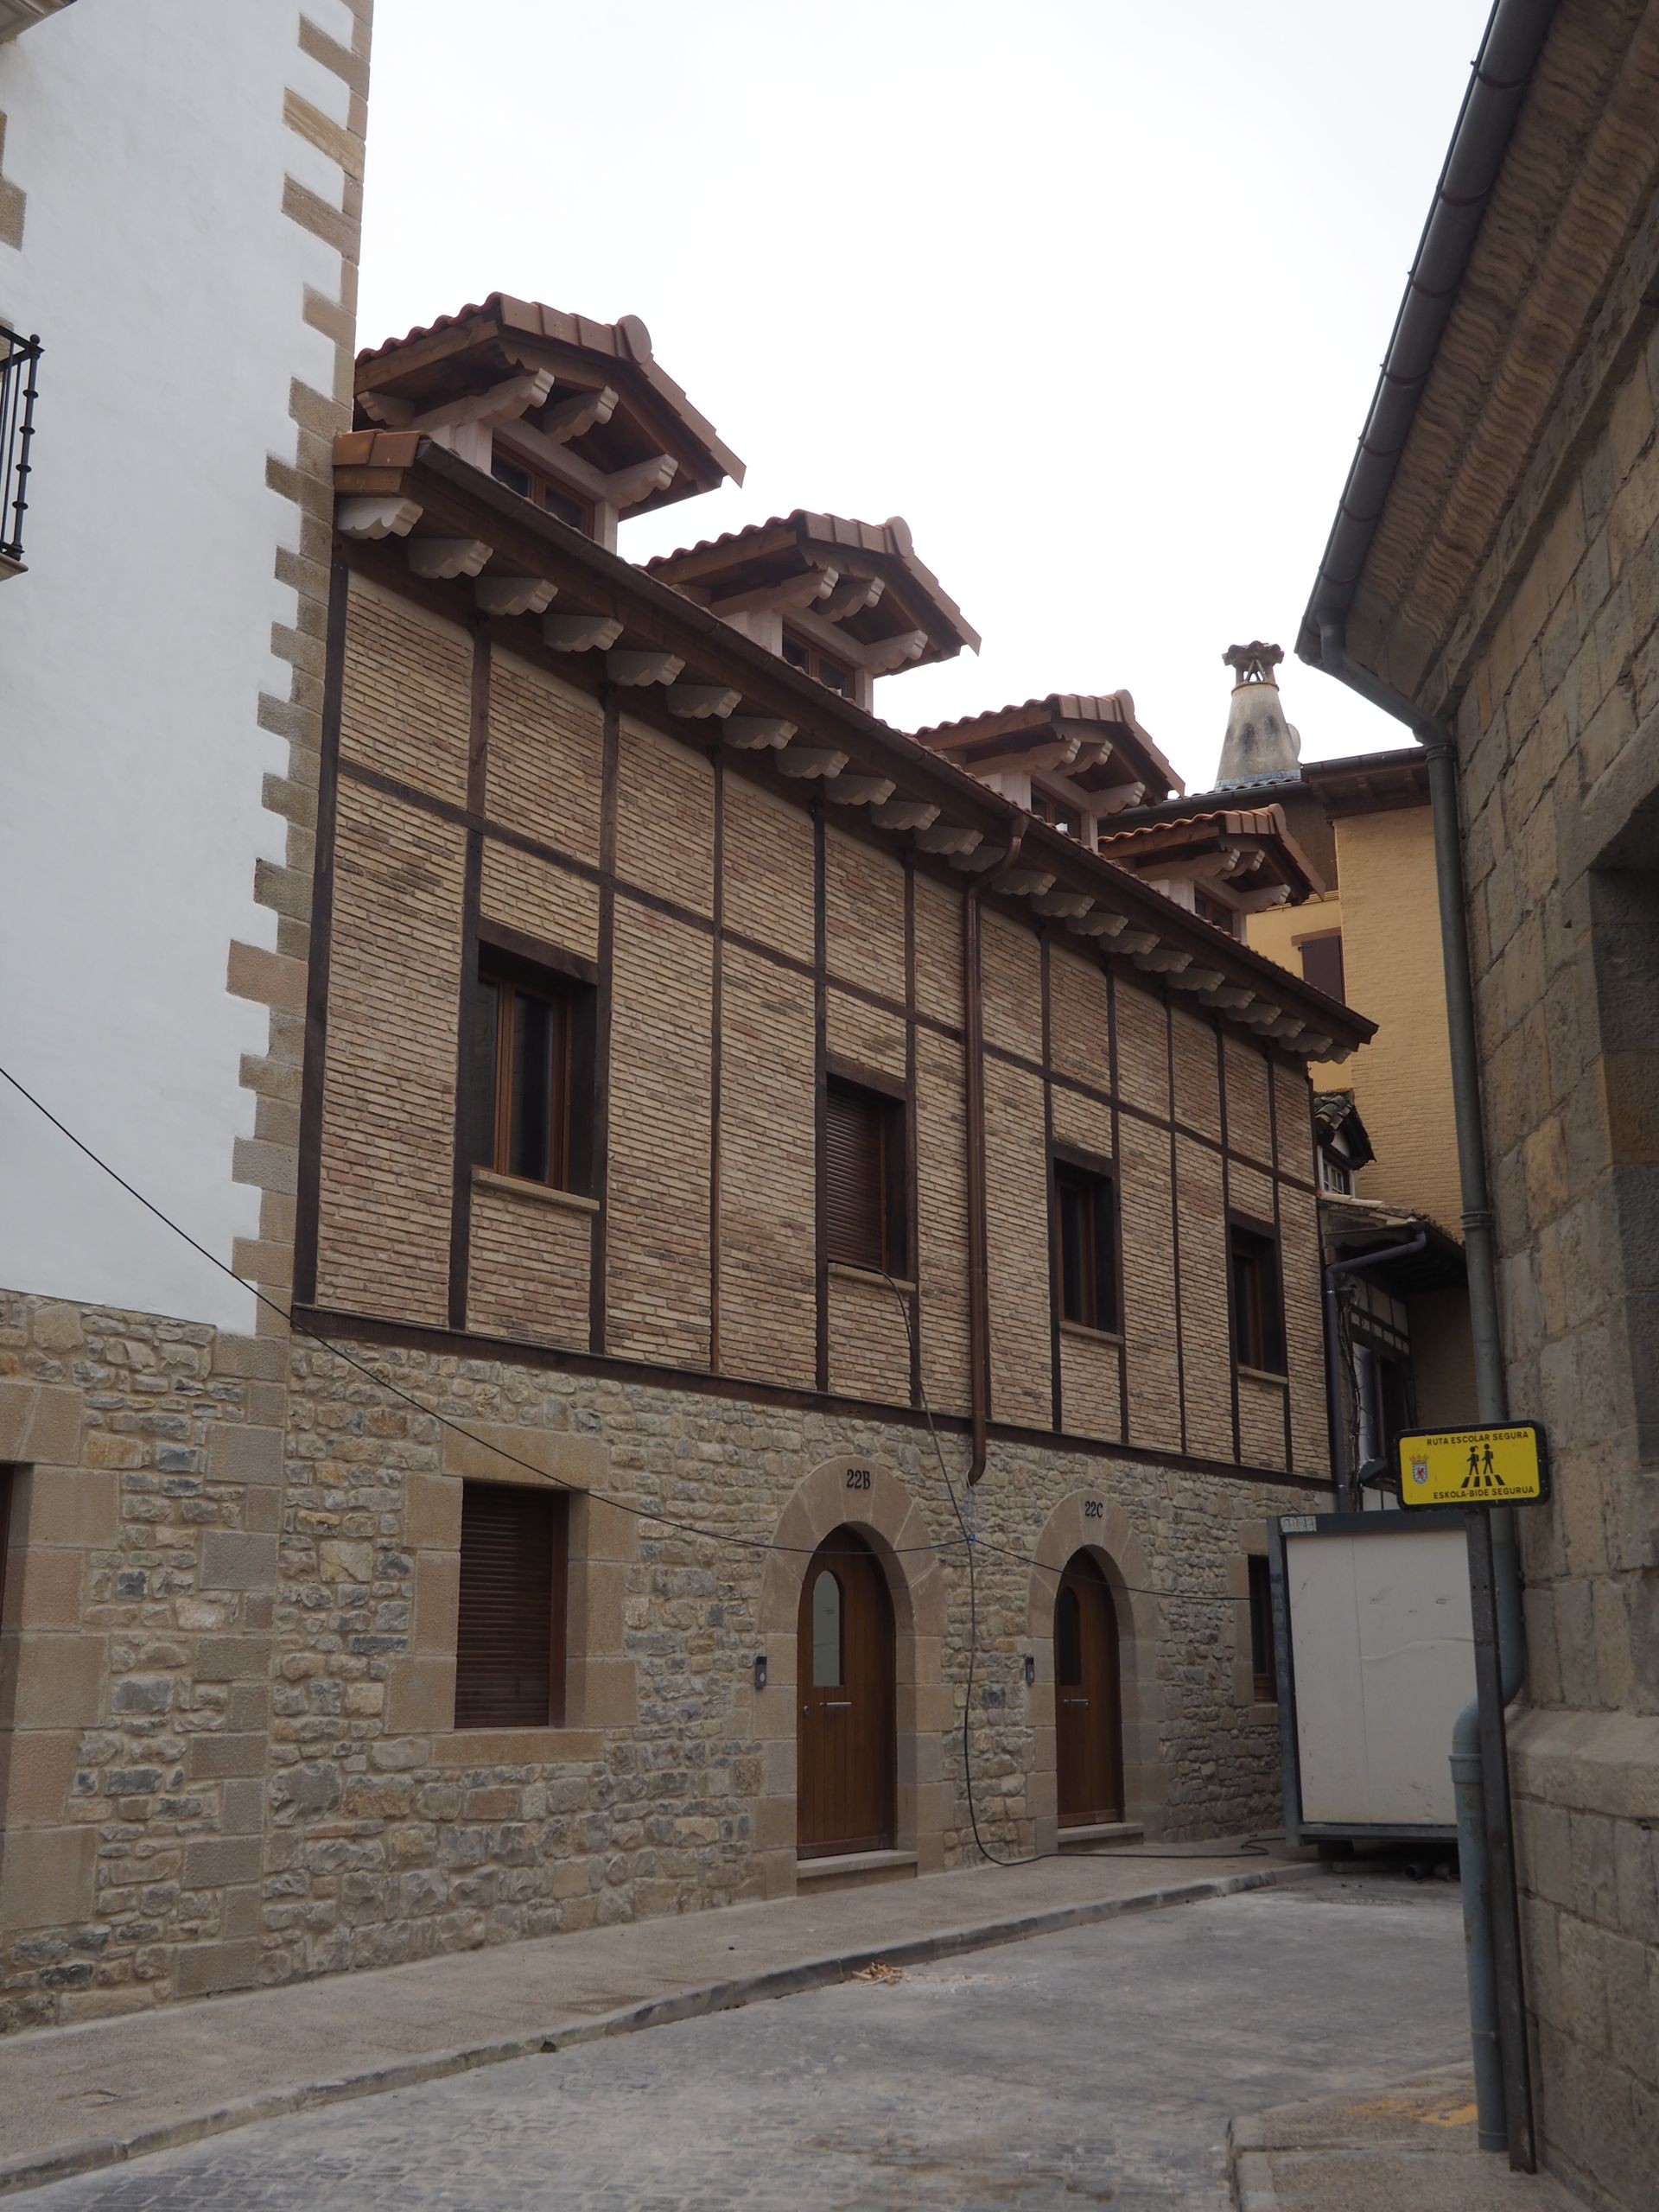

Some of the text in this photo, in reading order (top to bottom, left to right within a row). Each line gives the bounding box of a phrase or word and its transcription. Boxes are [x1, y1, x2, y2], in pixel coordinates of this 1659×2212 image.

[1451, 1434, 1491, 1444] ESCOLAR
[1493, 1431, 1529, 1440] SEGURA
[847, 1469, 871, 1490] 22B
[1433, 1486, 1535, 1499] ESKOLA-BIDE SEGURUA
[1085, 1501, 1103, 1518] 22C
